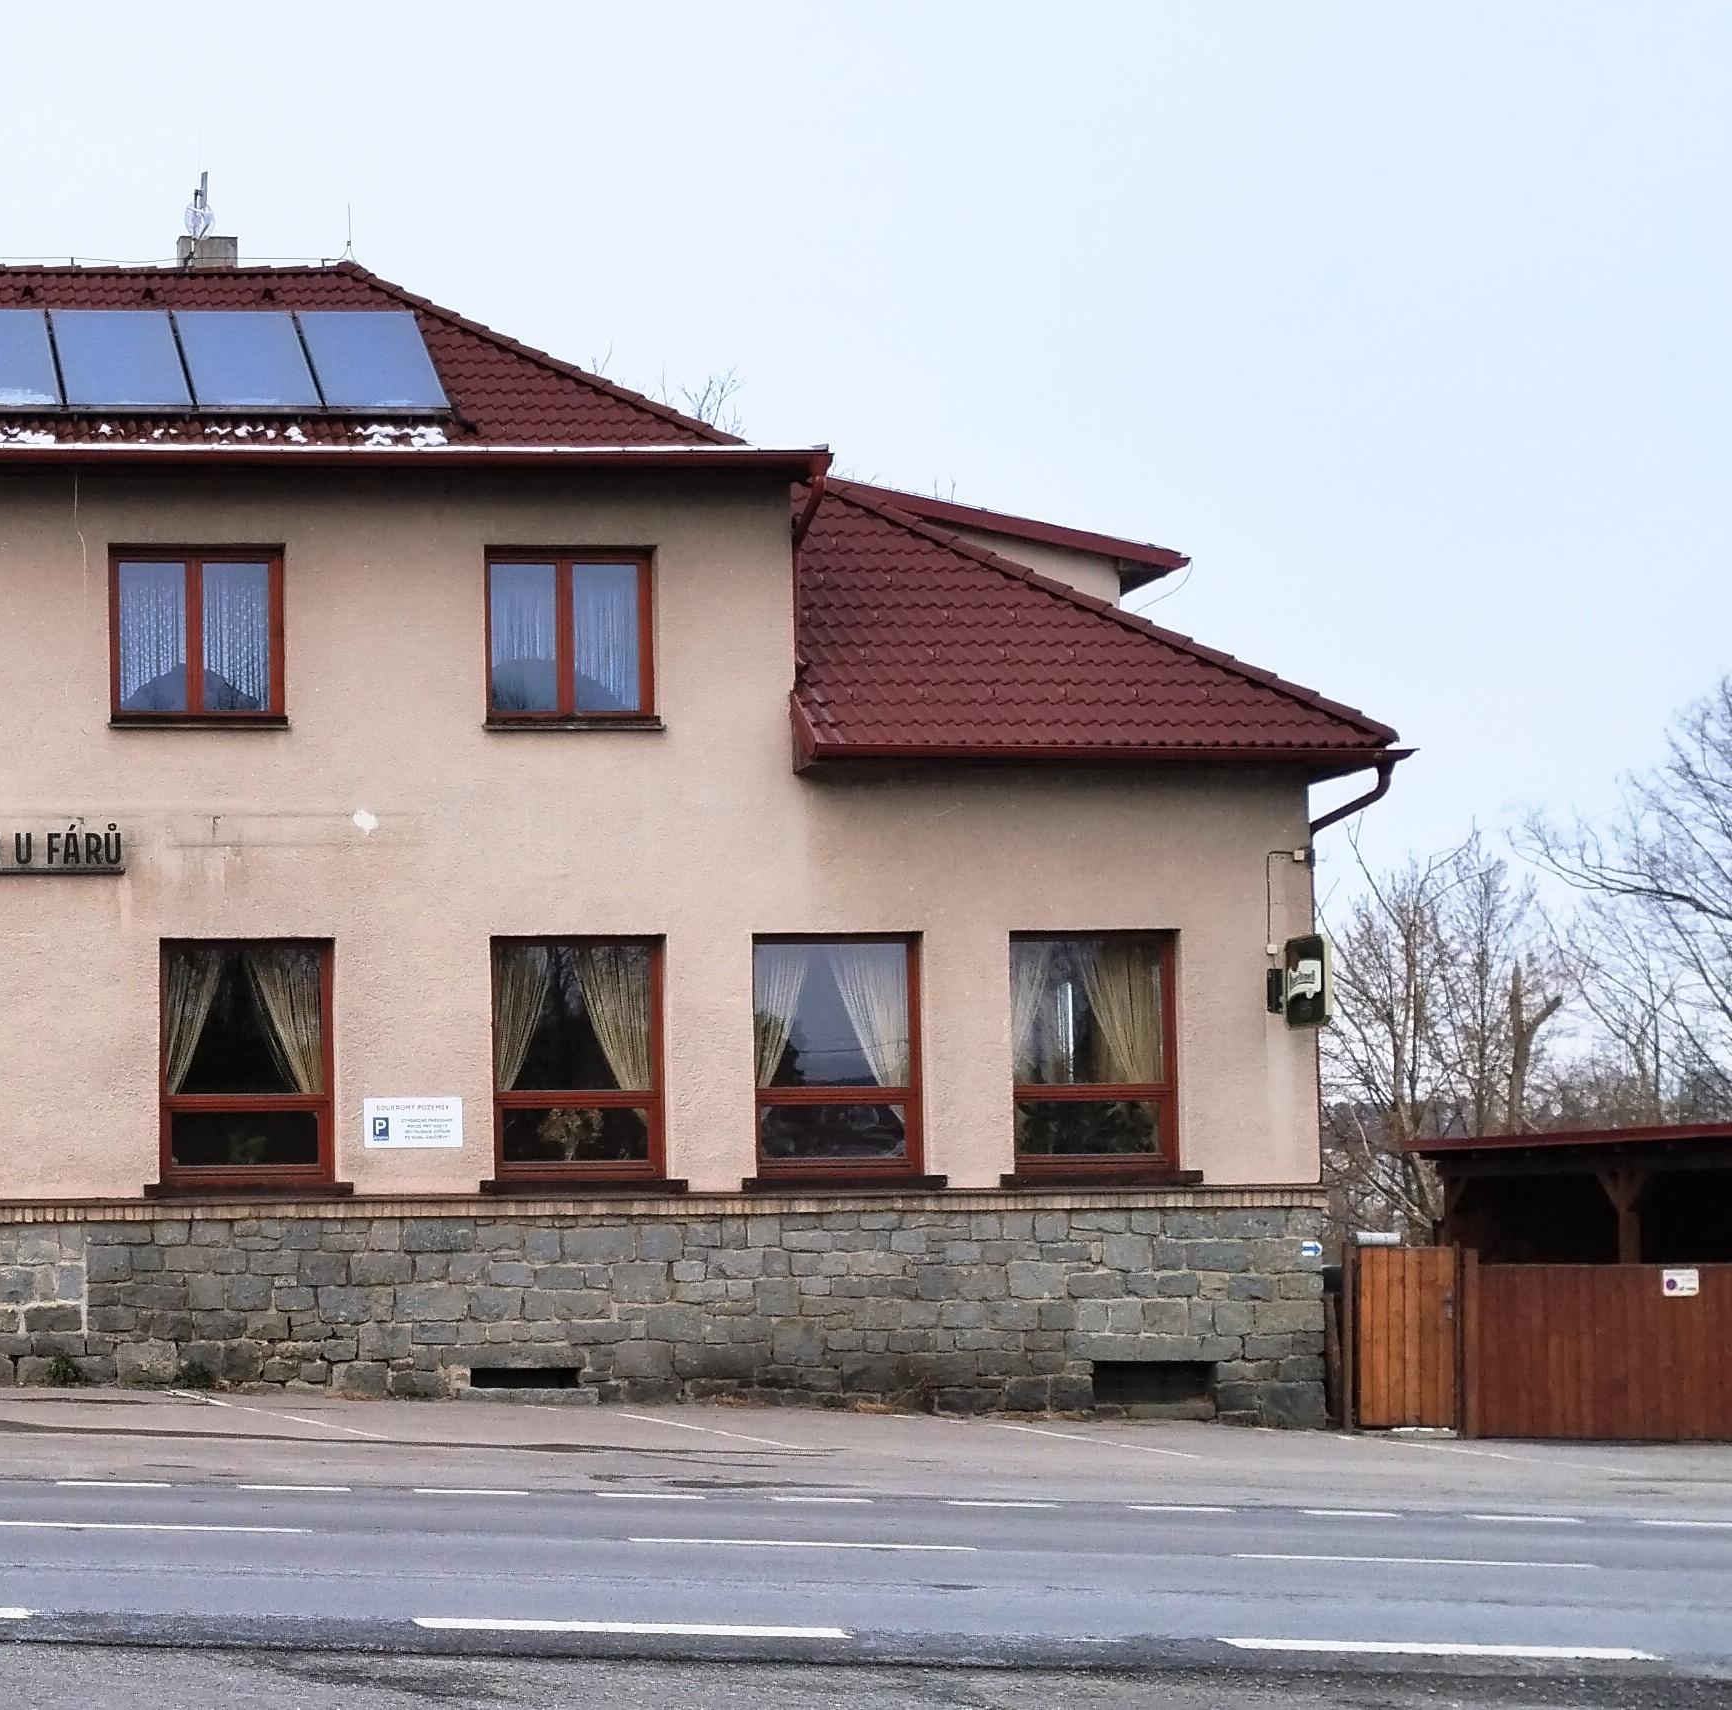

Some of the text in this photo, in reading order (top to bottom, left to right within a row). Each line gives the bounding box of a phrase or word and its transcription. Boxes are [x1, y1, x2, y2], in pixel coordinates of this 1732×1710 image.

[15, 832, 32, 865] U
[47, 822, 122, 865] FÁRŮ
[375, 1119, 387, 1135] P
